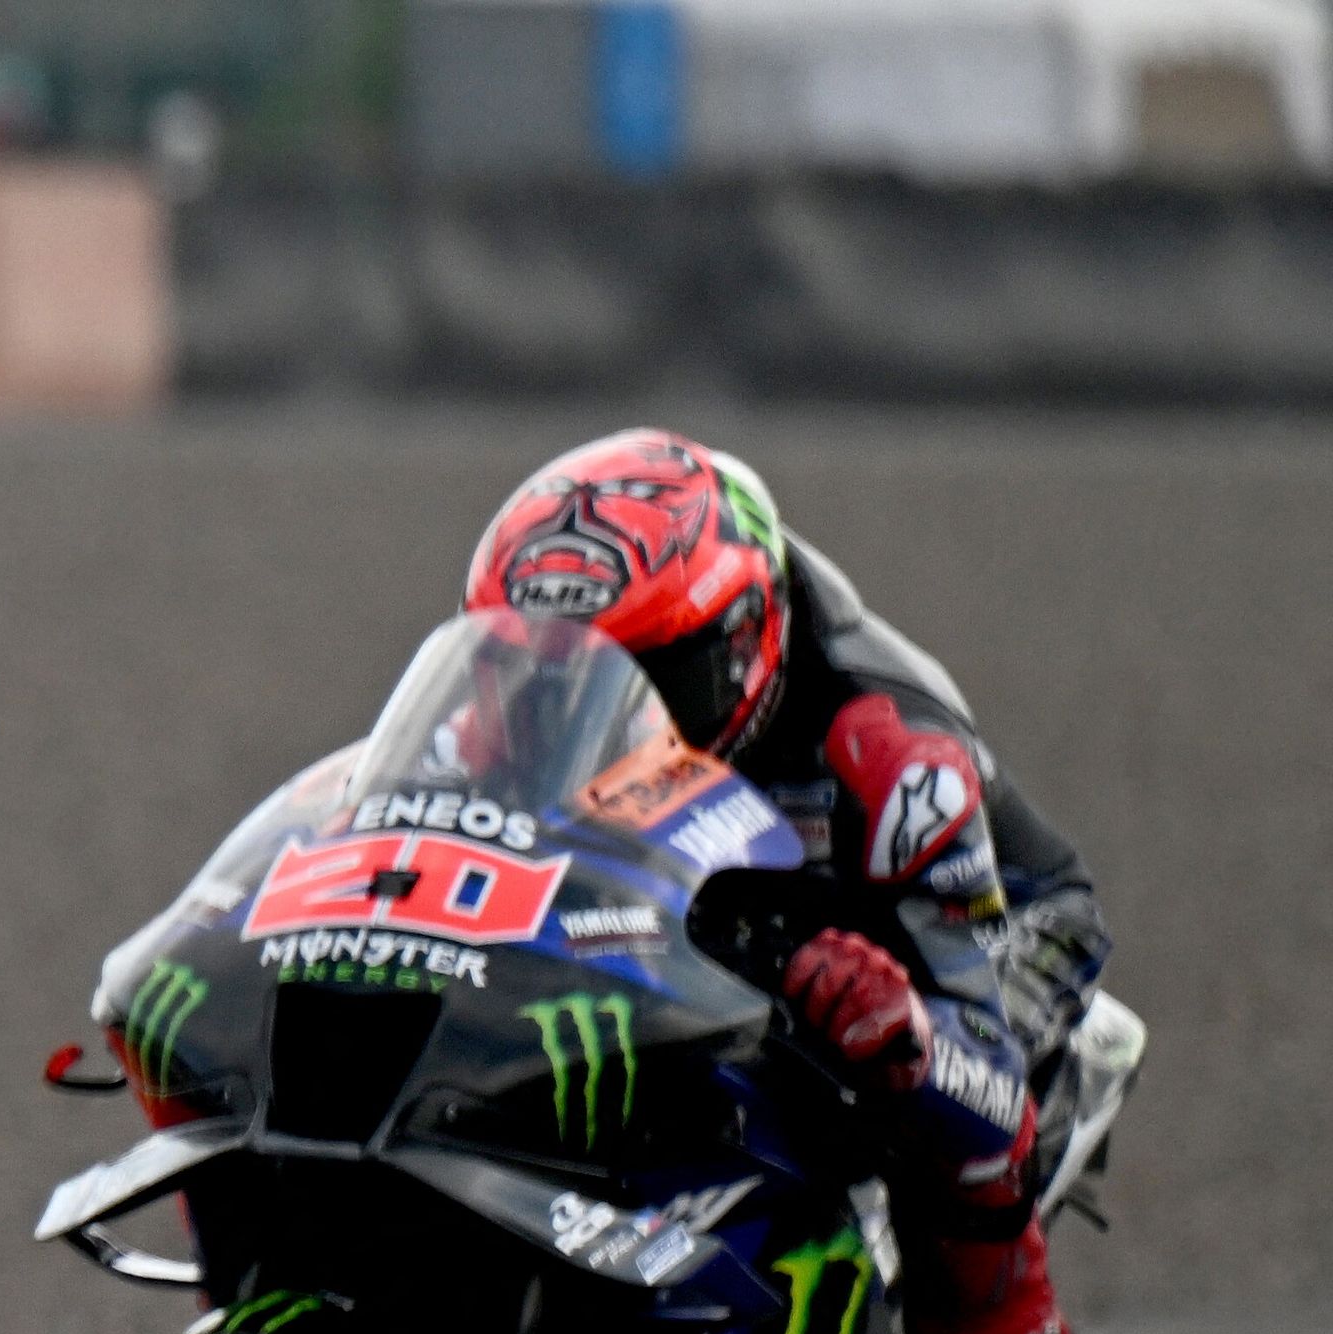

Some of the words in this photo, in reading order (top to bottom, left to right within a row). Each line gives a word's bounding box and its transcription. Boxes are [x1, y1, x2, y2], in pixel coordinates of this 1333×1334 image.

[353, 792, 537, 850] ENEOS
[242, 836, 571, 944] 20
[260, 928, 488, 988] MONSTER
